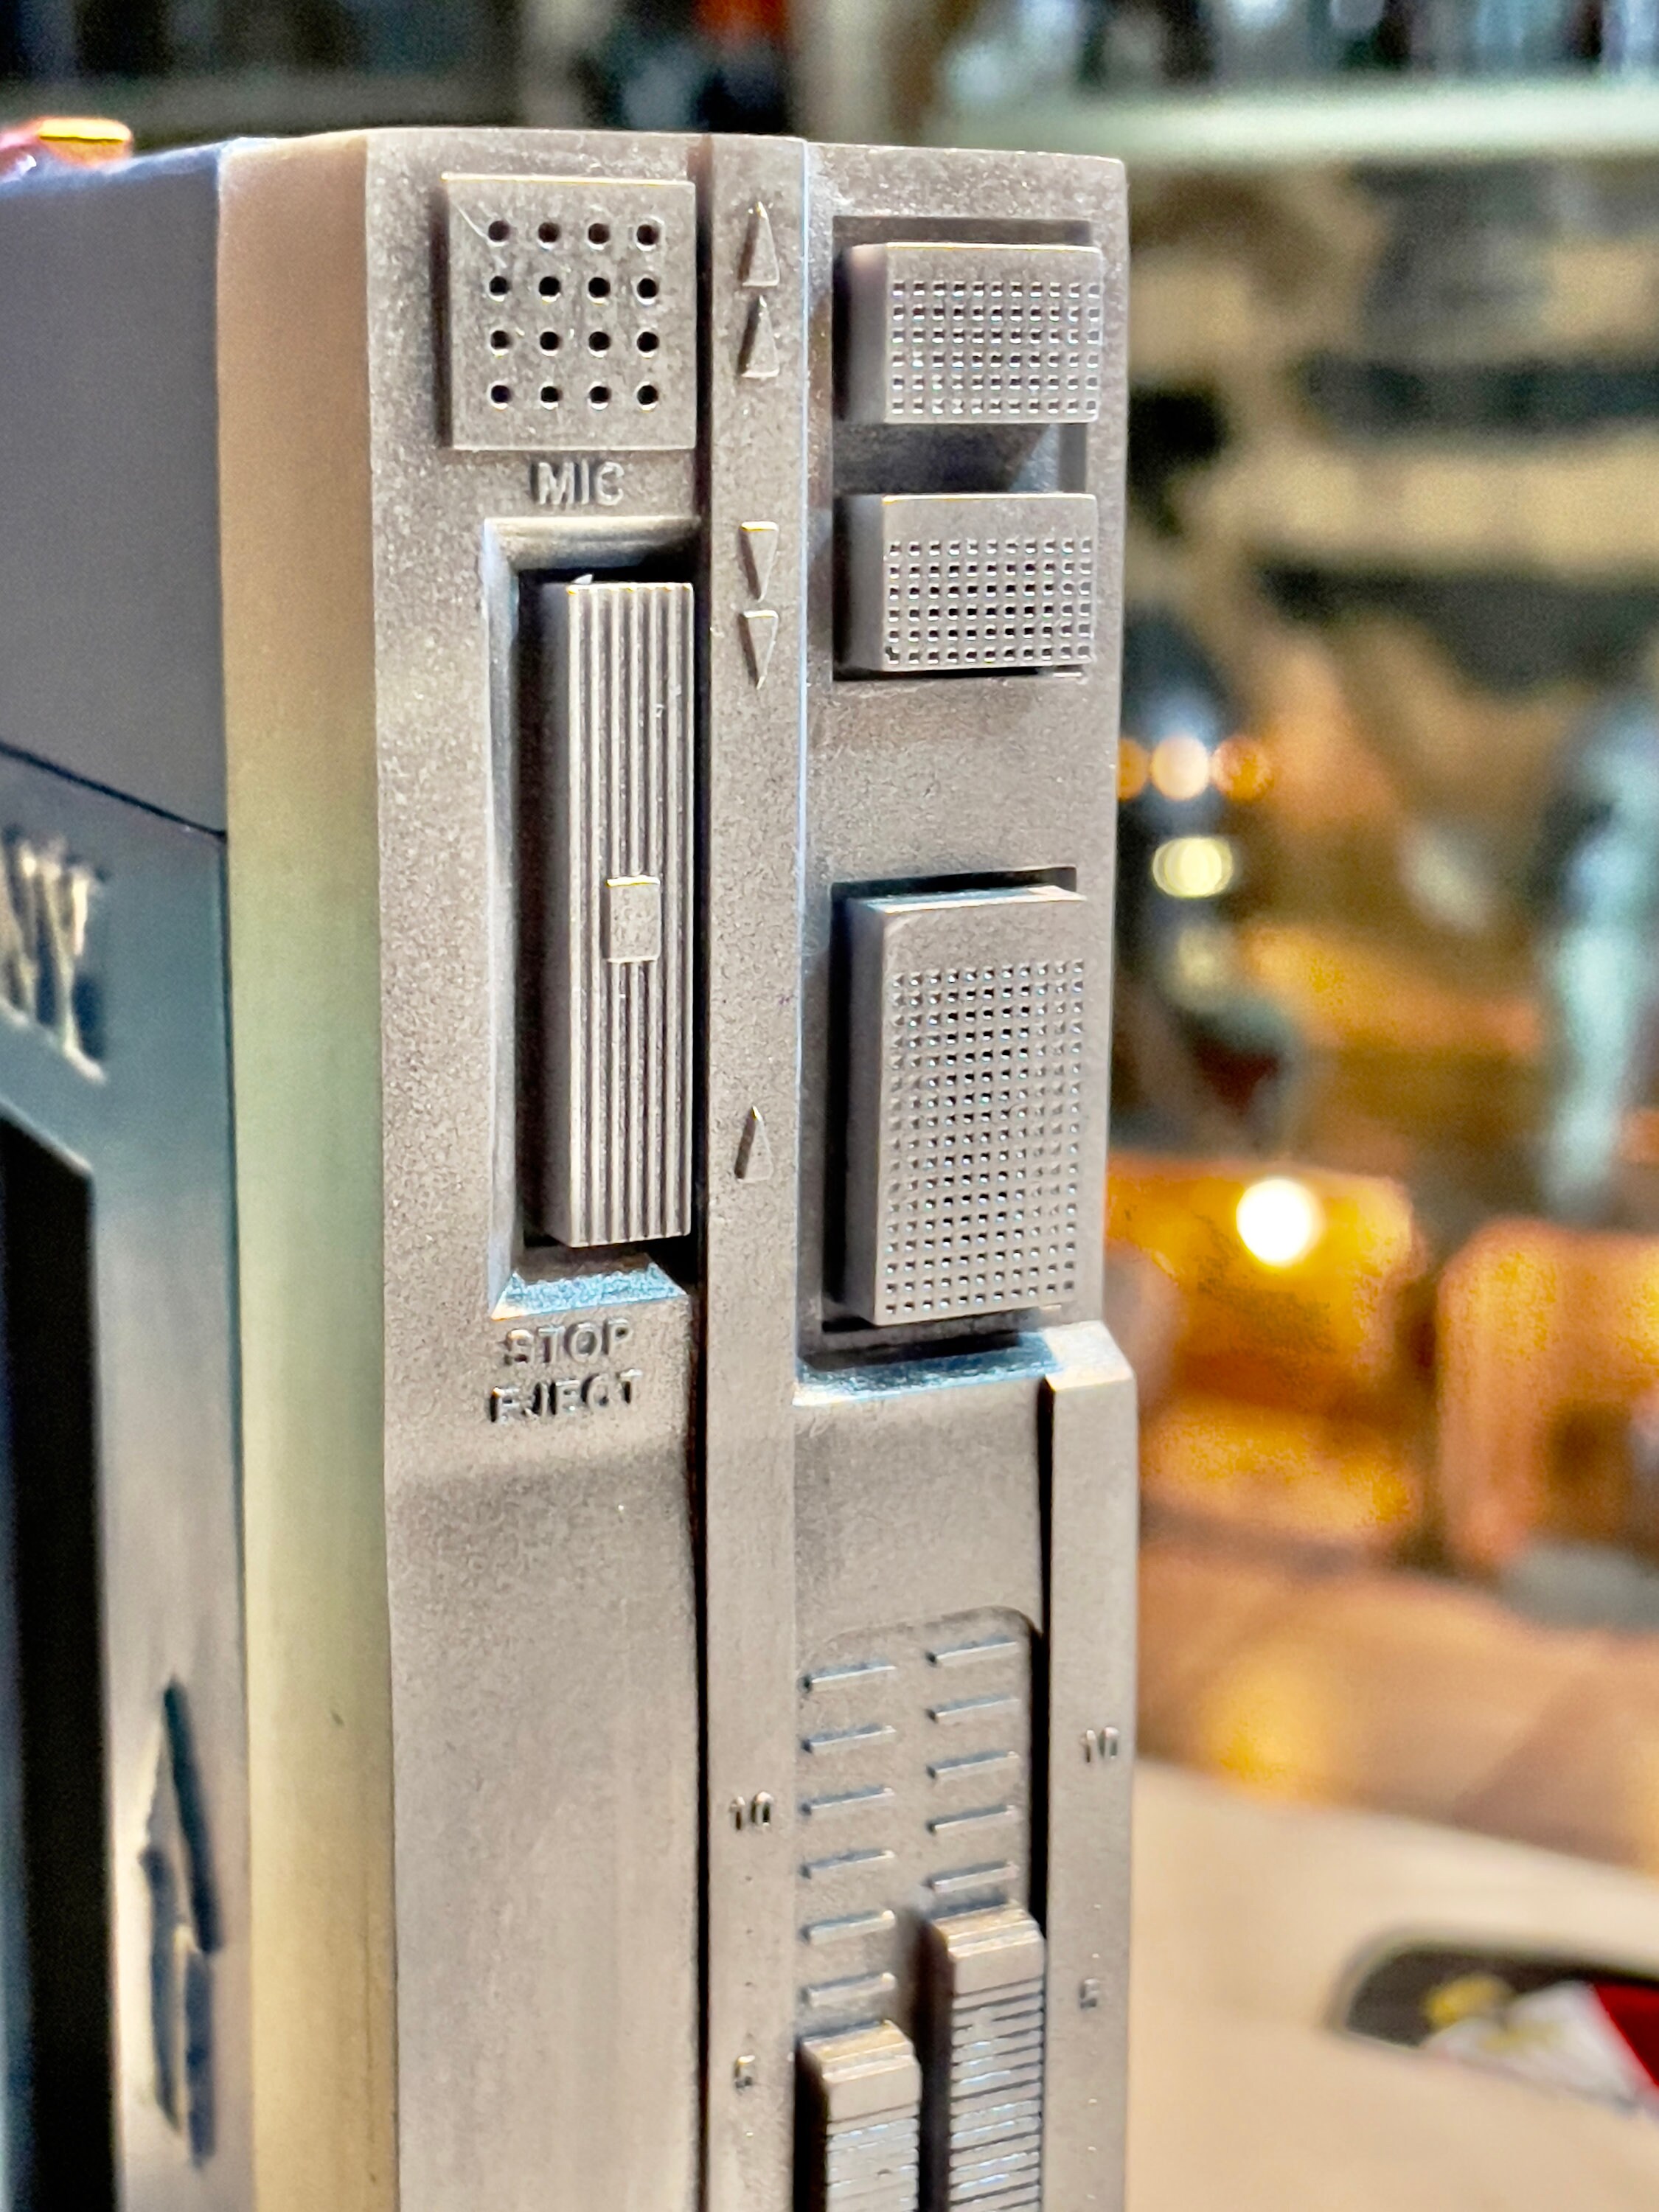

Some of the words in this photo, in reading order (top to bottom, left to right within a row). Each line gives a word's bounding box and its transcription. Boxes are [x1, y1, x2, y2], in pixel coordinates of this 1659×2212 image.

[530, 459, 625, 507] MIC
[504, 1317, 633, 1364] STOP
[490, 1368, 643, 1425] EJECT
